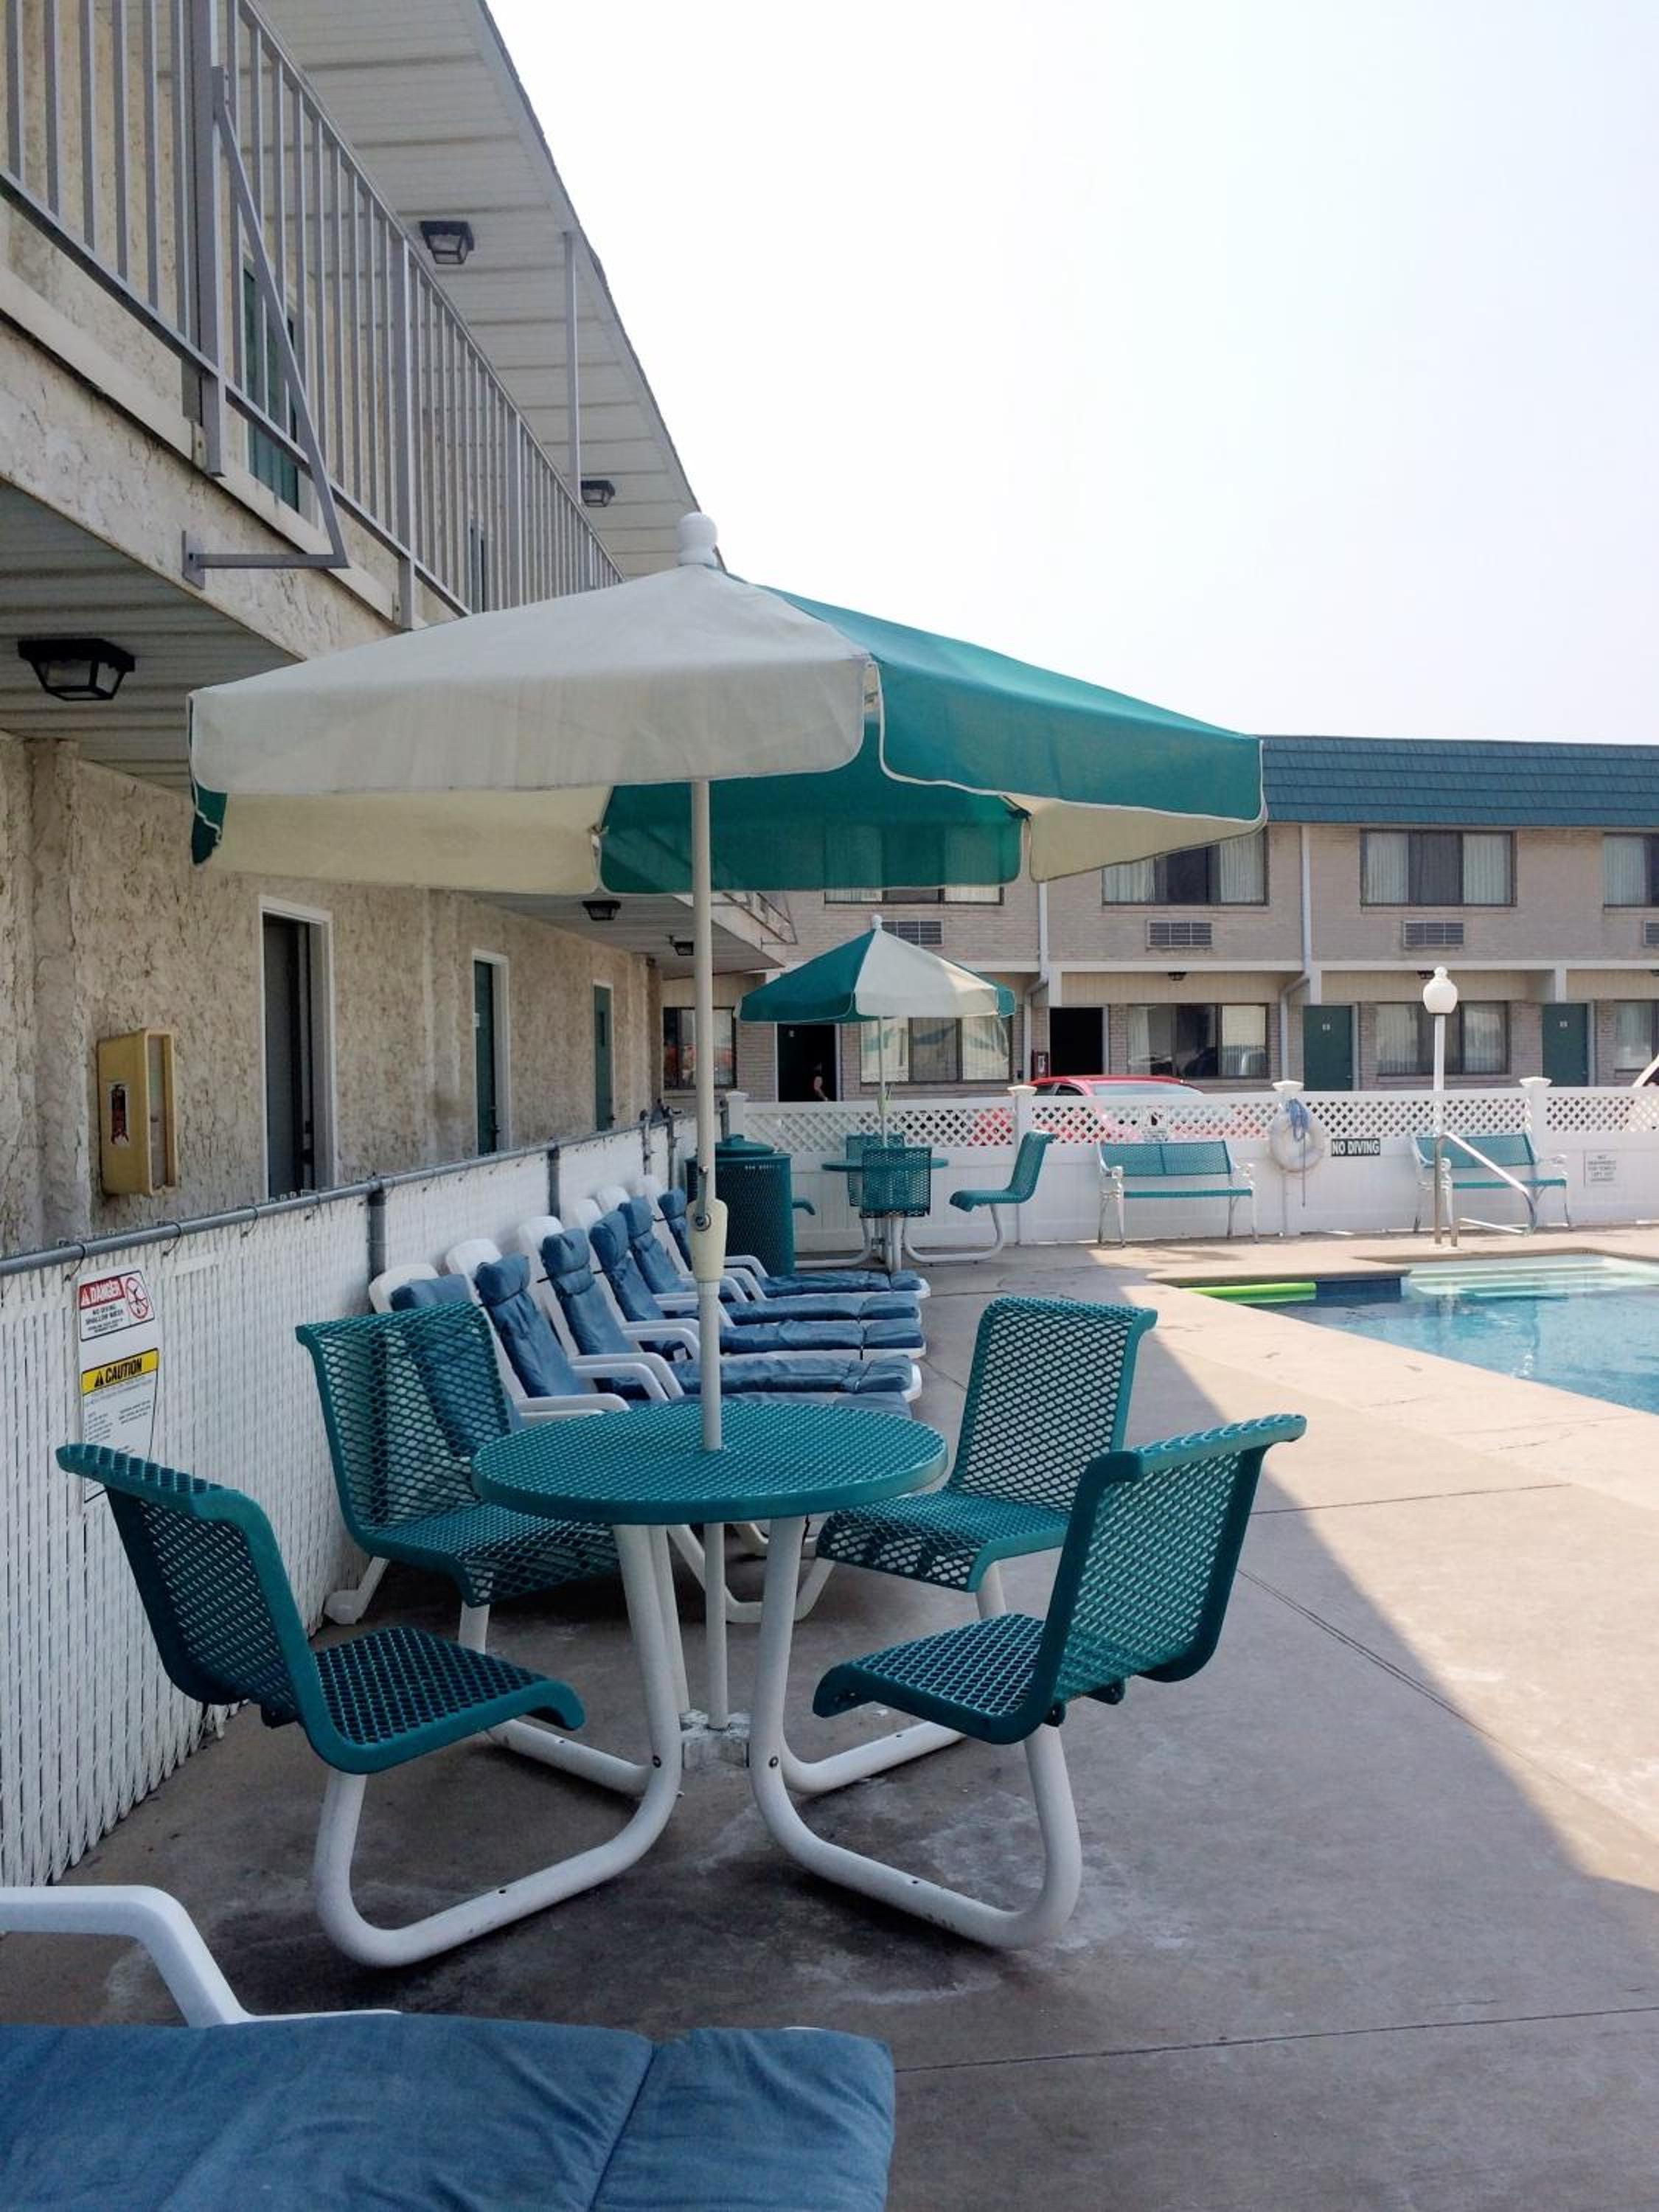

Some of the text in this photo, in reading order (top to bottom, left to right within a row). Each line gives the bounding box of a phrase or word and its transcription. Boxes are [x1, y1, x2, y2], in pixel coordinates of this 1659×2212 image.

[1332, 1139, 1380, 1155] NO DIVING
[90, 1280, 122, 1304] DANGER
[105, 1358, 142, 1383] CAUTION
